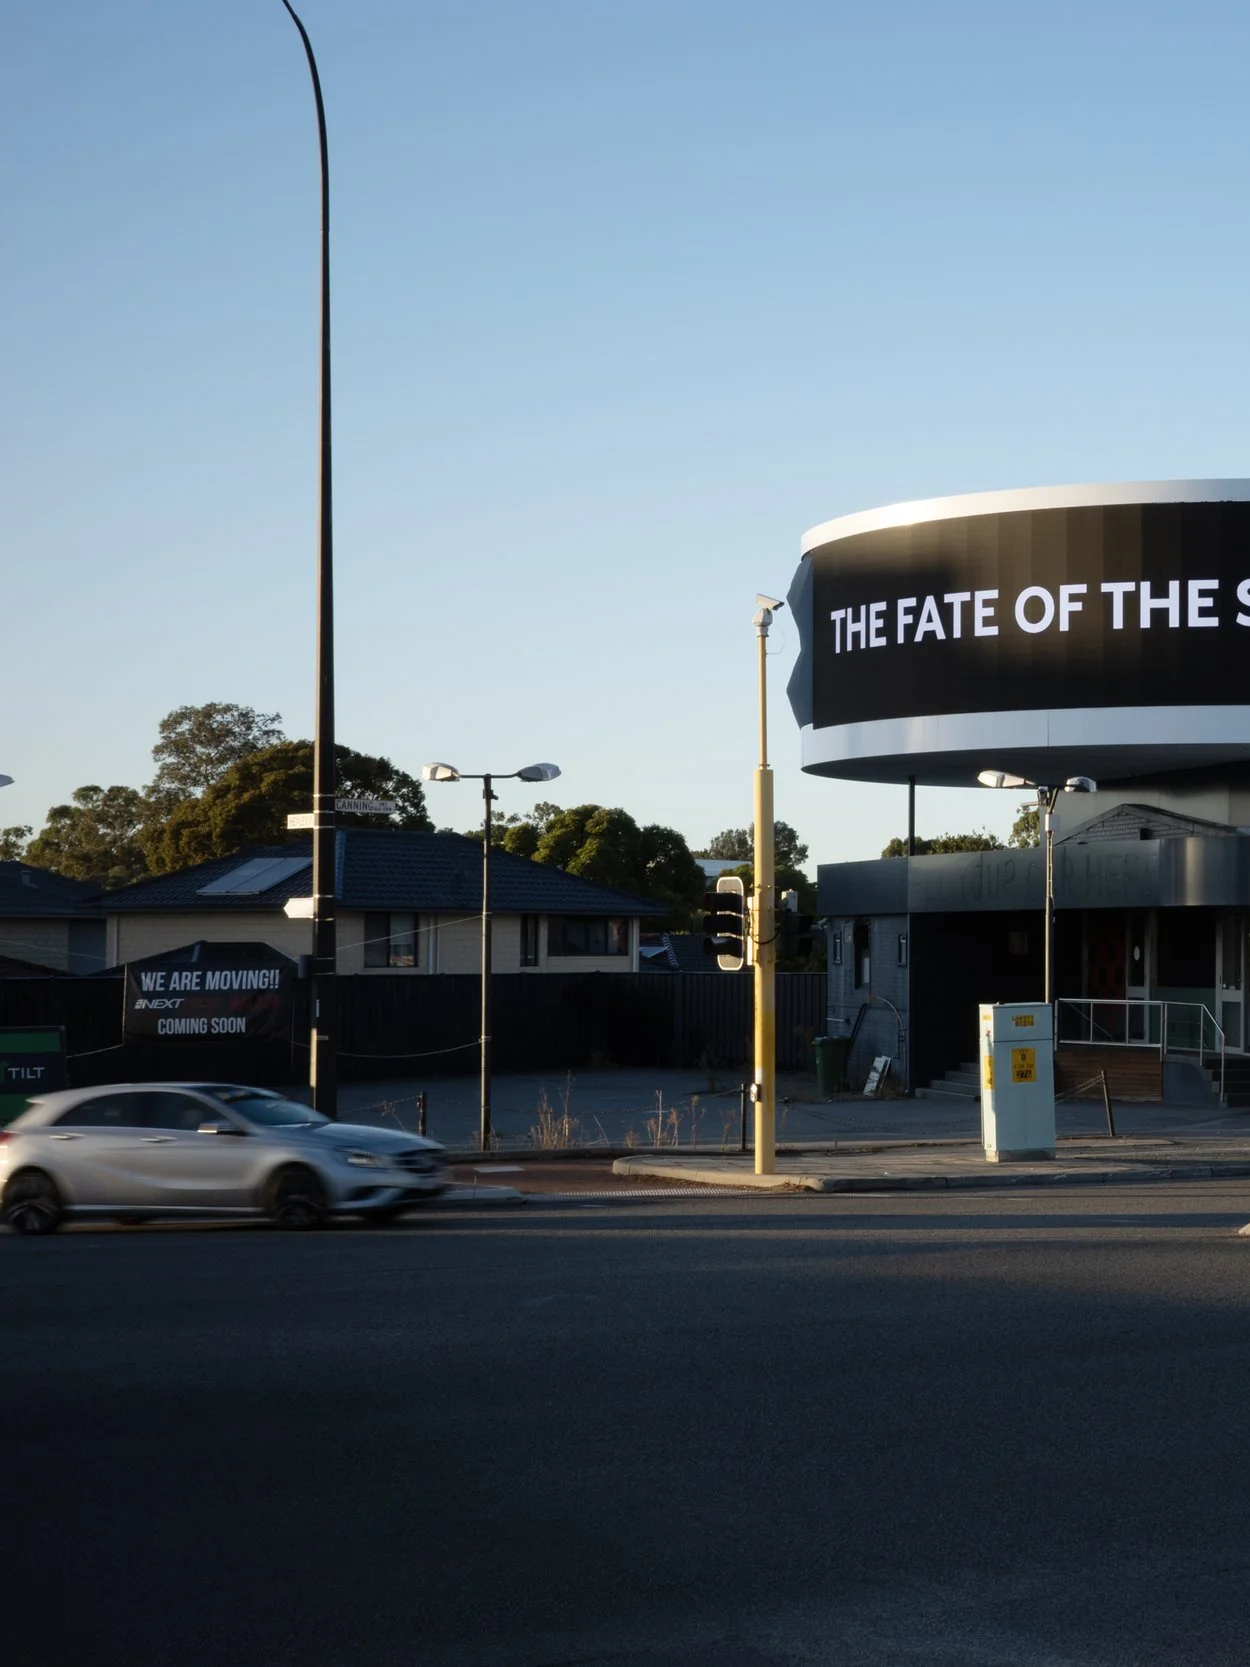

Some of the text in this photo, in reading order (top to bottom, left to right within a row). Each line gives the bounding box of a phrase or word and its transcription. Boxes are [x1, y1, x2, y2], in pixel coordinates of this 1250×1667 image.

[830, 600, 887, 654] THE
[897, 589, 999, 644] FATE
[1014, 584, 1088, 634] OF
[1100, 579, 1219, 630] THE
[335, 799, 374, 812] CANNING
[141, 969, 280, 991] WE ARE MOVING!!
[157, 1017, 246, 1035] COMING SOON
[7, 1067, 45, 1079] TILT
